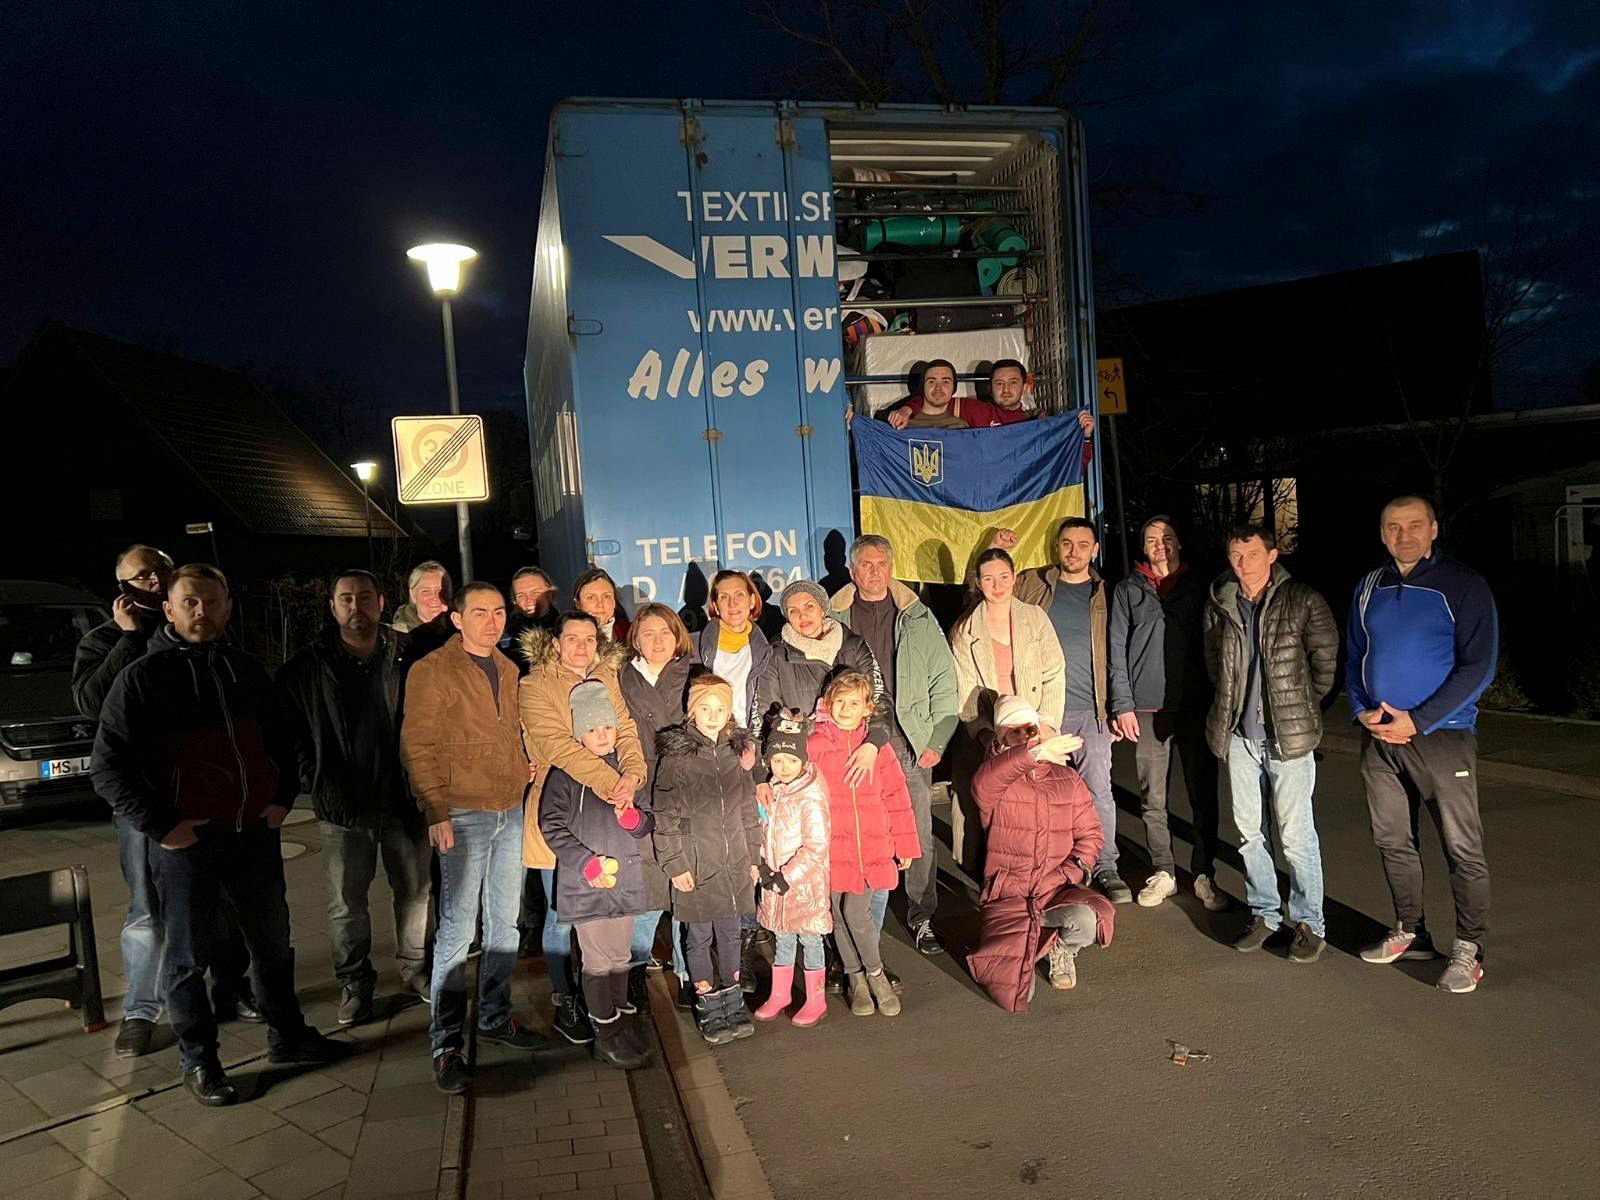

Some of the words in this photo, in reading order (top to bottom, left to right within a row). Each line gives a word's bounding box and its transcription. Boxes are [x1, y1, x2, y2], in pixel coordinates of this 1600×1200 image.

[602, 235, 834, 279] VERW
[627, 348, 769, 400] Alles
[804, 358, 841, 394] w
[423, 481, 466, 495] ZONE
[635, 529, 797, 567] TELEFON
[52, 761, 71, 774] MS
